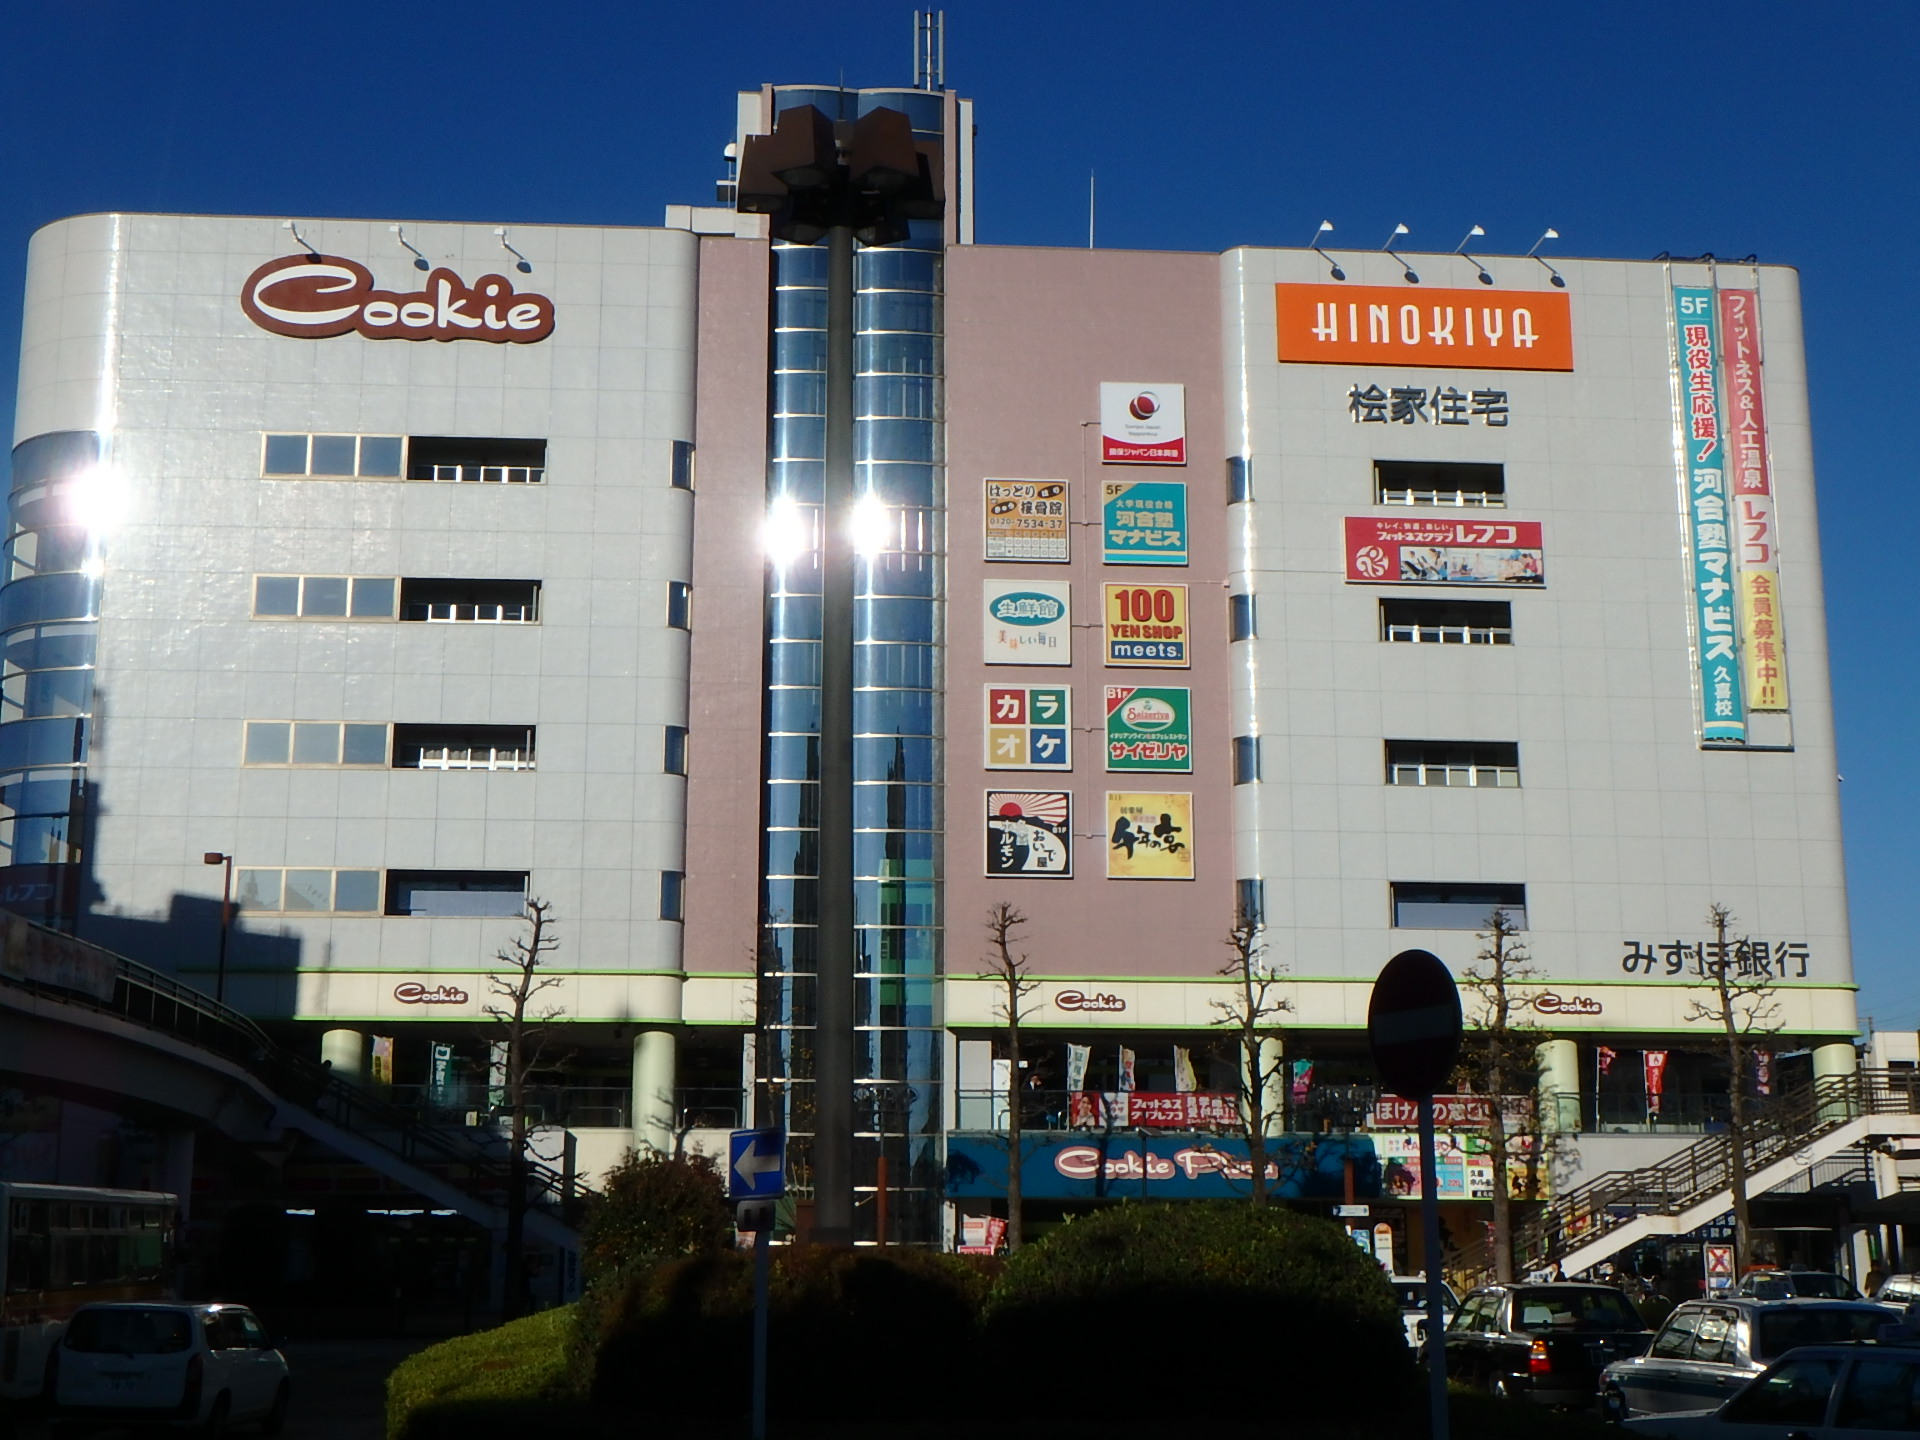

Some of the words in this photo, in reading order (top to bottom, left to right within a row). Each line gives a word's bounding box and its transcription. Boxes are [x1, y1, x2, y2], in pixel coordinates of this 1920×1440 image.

[252, 263, 543, 332] Cookie
[1680, 296, 1709, 315] 5F
[1311, 301, 1540, 350] HINOKIYA
[1348, 383, 1511, 429] 桧家住宅
[989, 483, 1036, 499] はっとり
[1106, 484, 1122, 495] 5F
[1020, 501, 1064, 516] 接骨院
[1115, 510, 1174, 528] 河合塾
[1108, 529, 1182, 548] マナビス
[1376, 531, 1454, 543] フィットネスクラブ
[1456, 524, 1517, 544] レフコ
[1742, 500, 1770, 564] レフコ
[1693, 467, 1736, 662] 河合塾マナビス
[998, 598, 1059, 619] 生鮮館
[1114, 588, 1175, 623] 100
[1110, 623, 1141, 639] YEN
[1142, 624, 1183, 640] SHOP
[1713, 665, 1734, 718] 久喜校
[1110, 741, 1188, 761] サイゼリヤ
[999, 820, 1015, 869] ホルモン
[1622, 939, 1810, 978] みずほ銀行
[395, 983, 466, 1003] Cookie
[1057, 991, 1125, 1011] Cookie
[1535, 994, 1602, 1014] Cookie
[1058, 1149, 1170, 1174] Cookie
